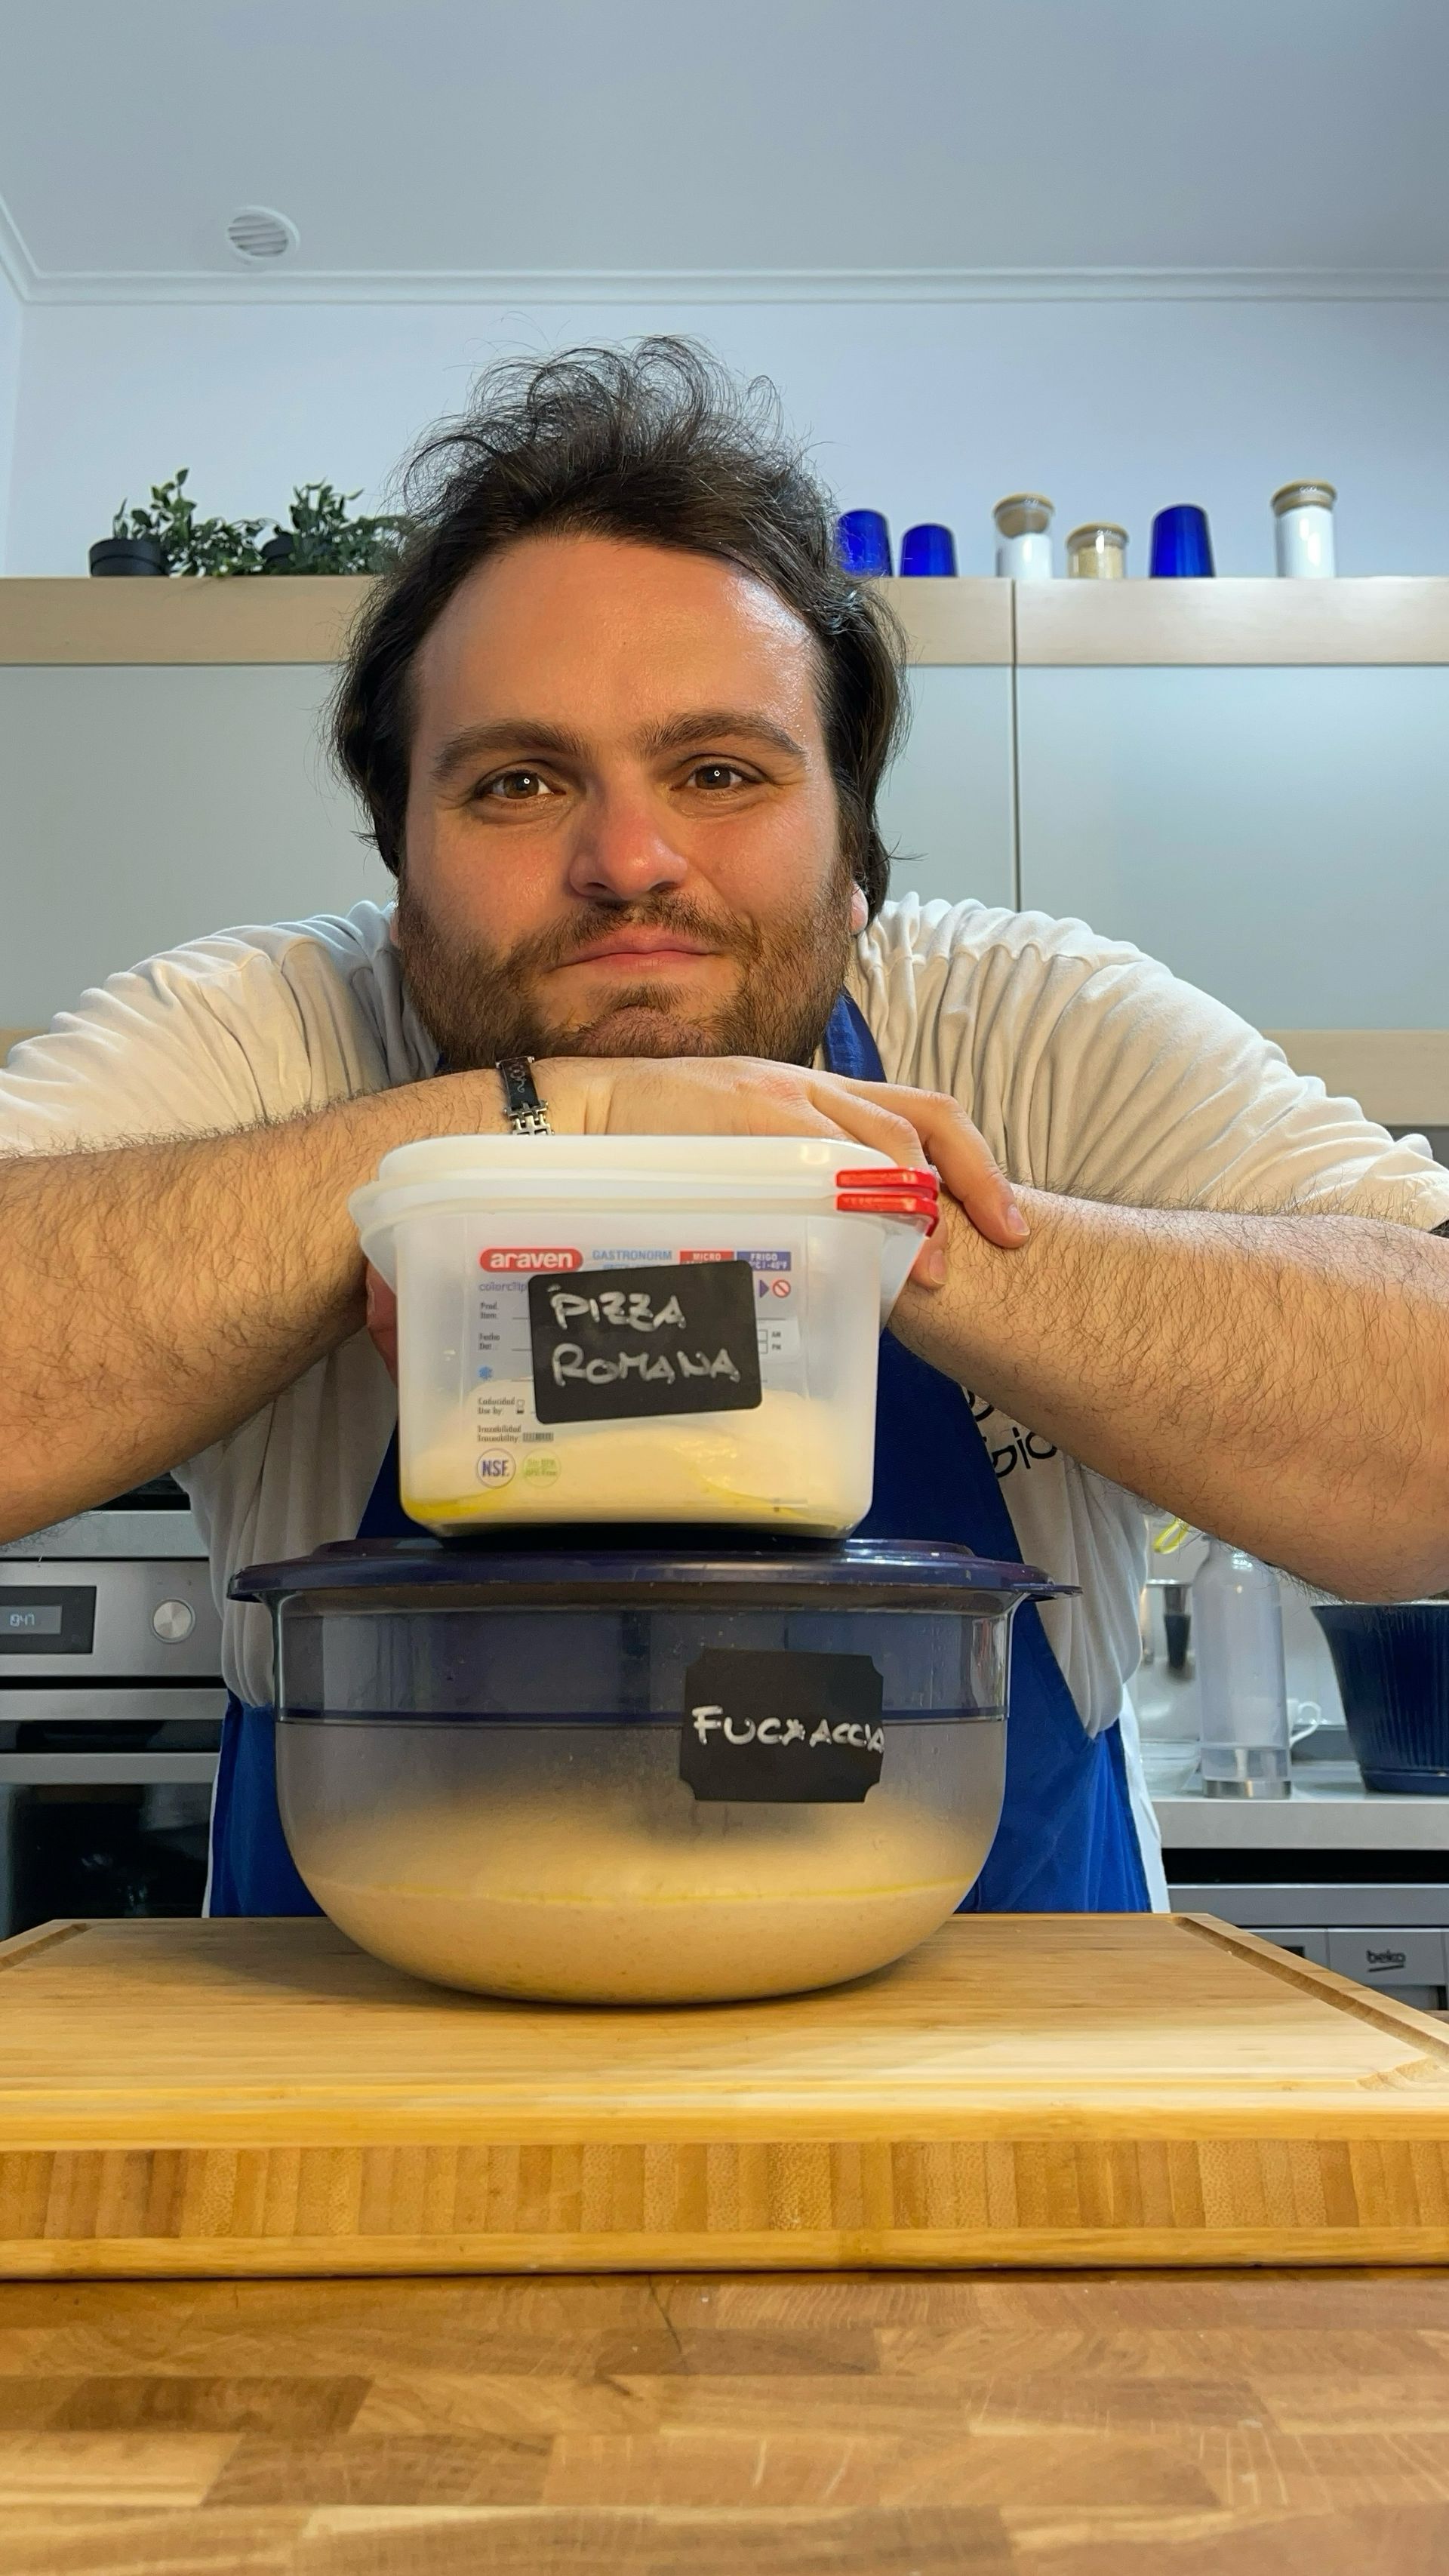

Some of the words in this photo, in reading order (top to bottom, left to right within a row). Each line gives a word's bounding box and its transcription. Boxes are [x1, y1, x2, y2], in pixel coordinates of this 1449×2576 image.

[491, 1252, 573, 1269] araven
[592, 1250, 672, 1260] GASTRONORM
[693, 1253, 721, 1261] MICRO
[750, 1253, 777, 1261] FRIGO
[548, 1285, 686, 1331] PIZZA
[552, 1343, 740, 1387] ROMANA
[481, 1460, 509, 1477] NSF
